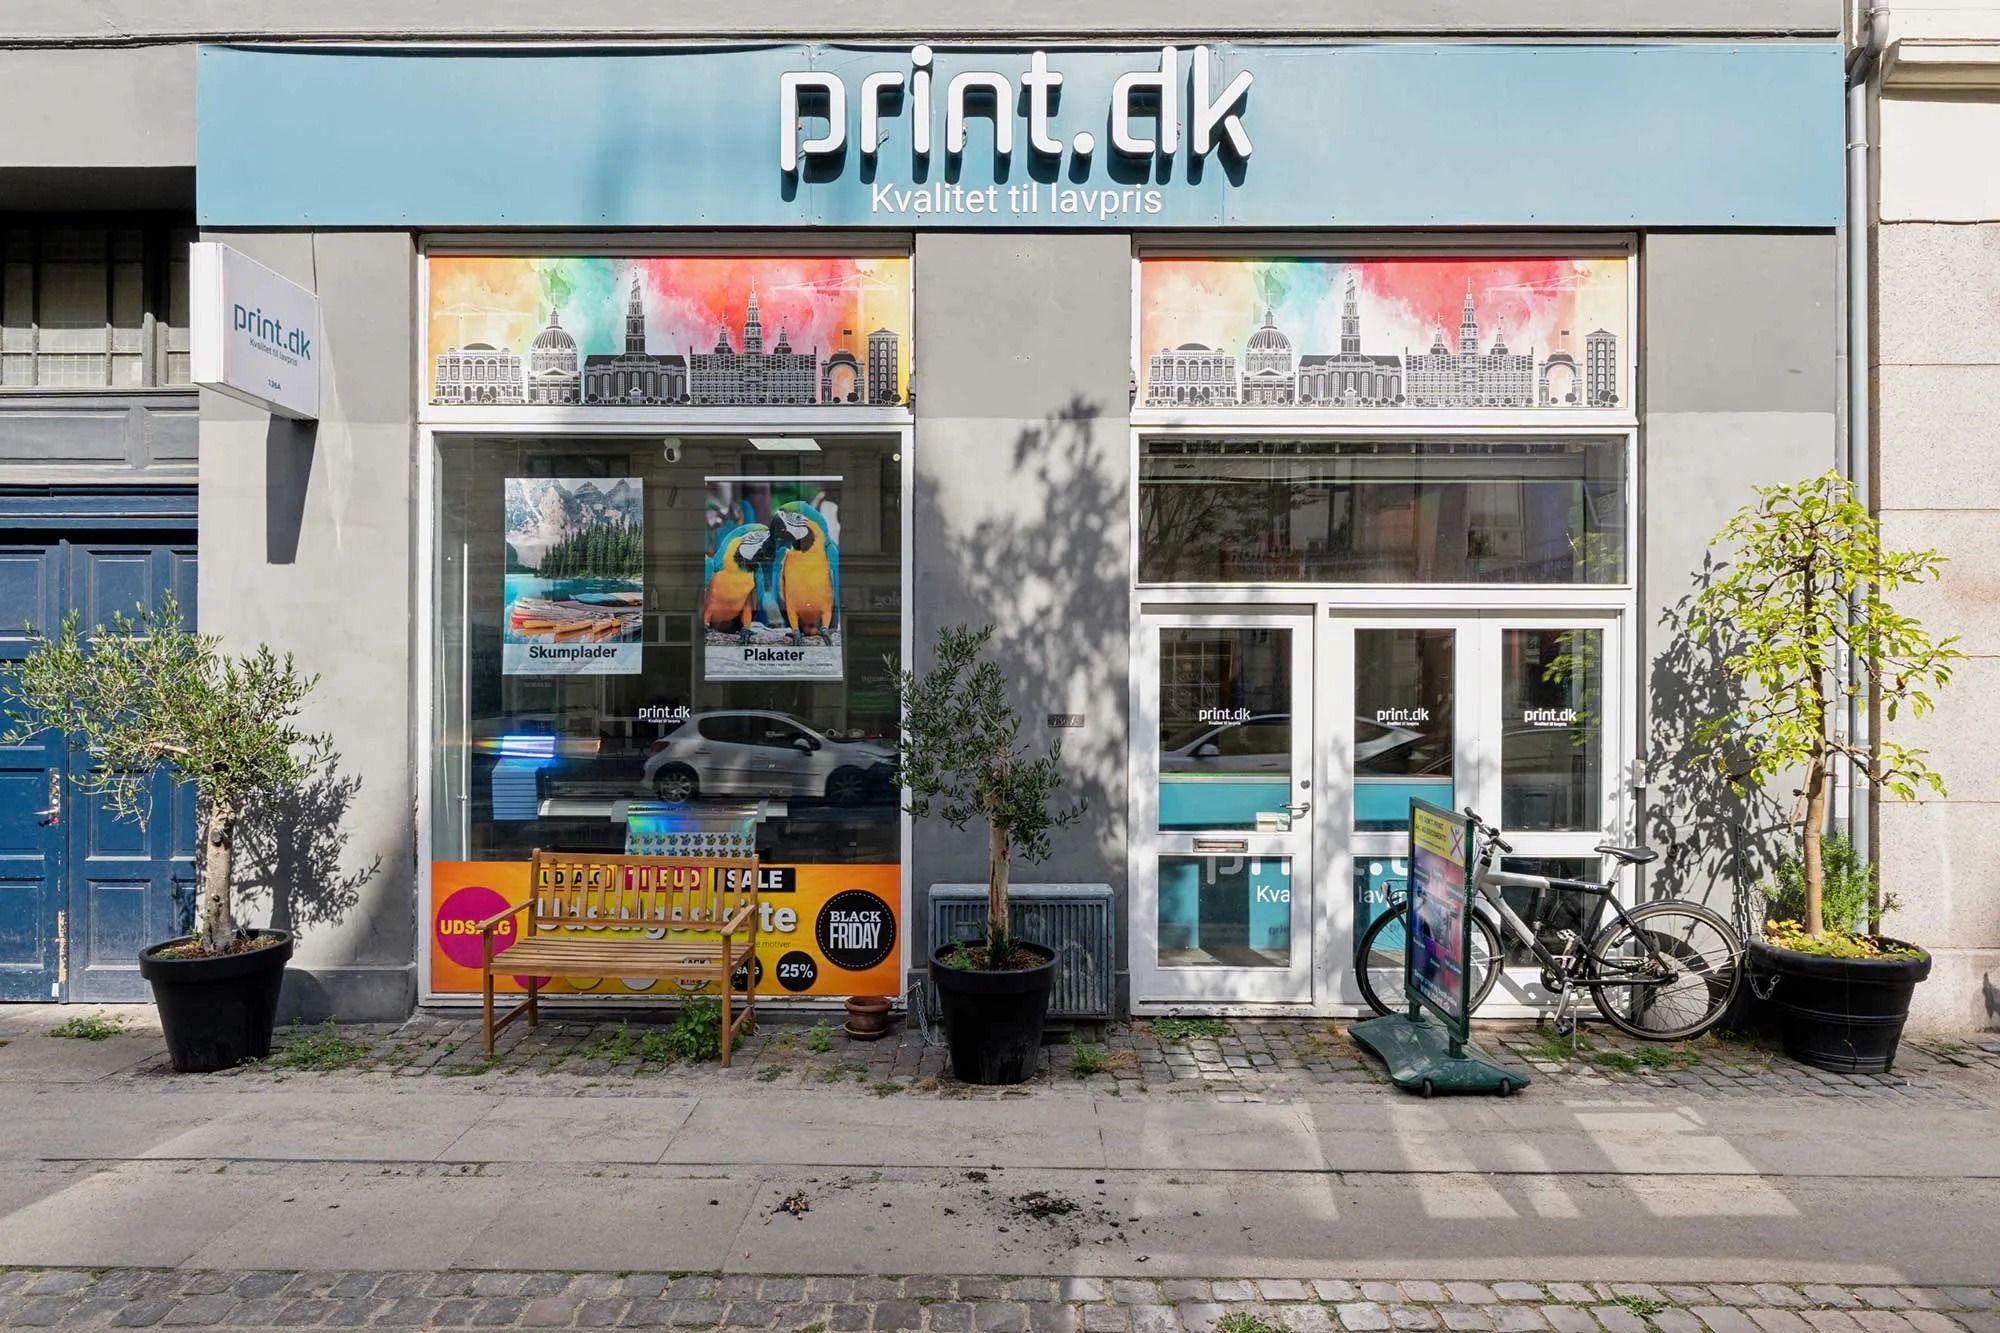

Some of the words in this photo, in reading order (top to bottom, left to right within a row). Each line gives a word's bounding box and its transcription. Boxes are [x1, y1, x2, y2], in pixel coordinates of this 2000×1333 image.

[780, 44, 1254, 171] print.dk
[872, 182, 998, 213] Kvalitet
[1008, 183, 1037, 213] til
[1051, 183, 1162, 221] lavpris
[234, 303, 311, 360] print.dk
[529, 646, 617, 661] Skumplader
[744, 648, 804, 661] Plakater
[638, 705, 690, 720] print.dk
[1199, 707, 1250, 721] print.dk
[1377, 707, 1429, 722] print.dk
[1524, 708, 1576, 723] print.dk
[830, 911, 881, 922] BLACK
[830, 922, 881, 949] FRIDAY
[761, 940, 791, 949] motiver
[780, 963, 814, 978] 25%
